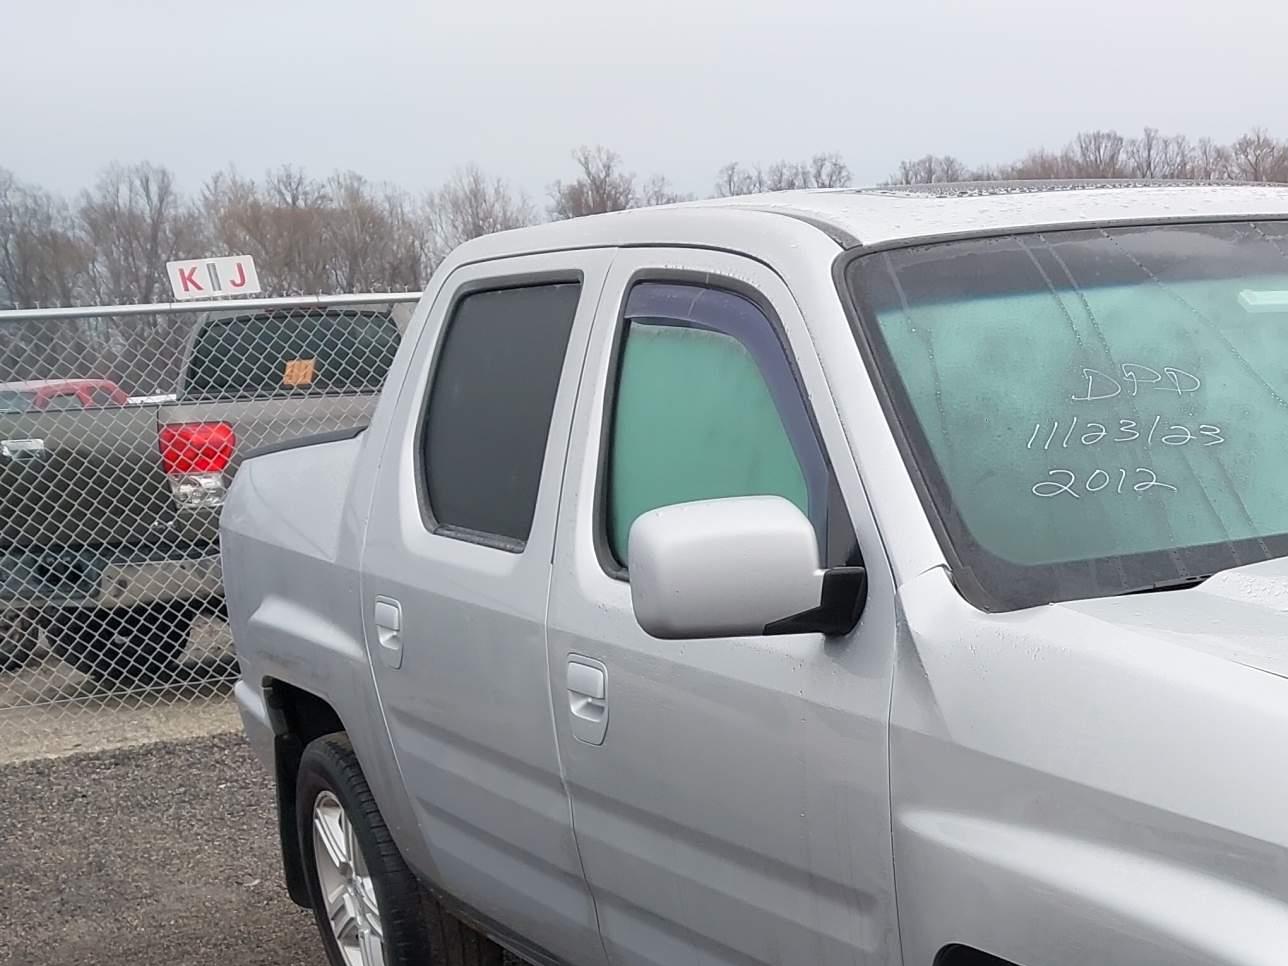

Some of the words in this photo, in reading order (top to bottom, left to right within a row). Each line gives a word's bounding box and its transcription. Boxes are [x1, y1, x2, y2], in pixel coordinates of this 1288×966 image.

[178, 266, 204, 292] K
[229, 262, 246, 288] J
[1026, 415, 1225, 450] 11/23/23
[1031, 468, 1178, 499] 2012
